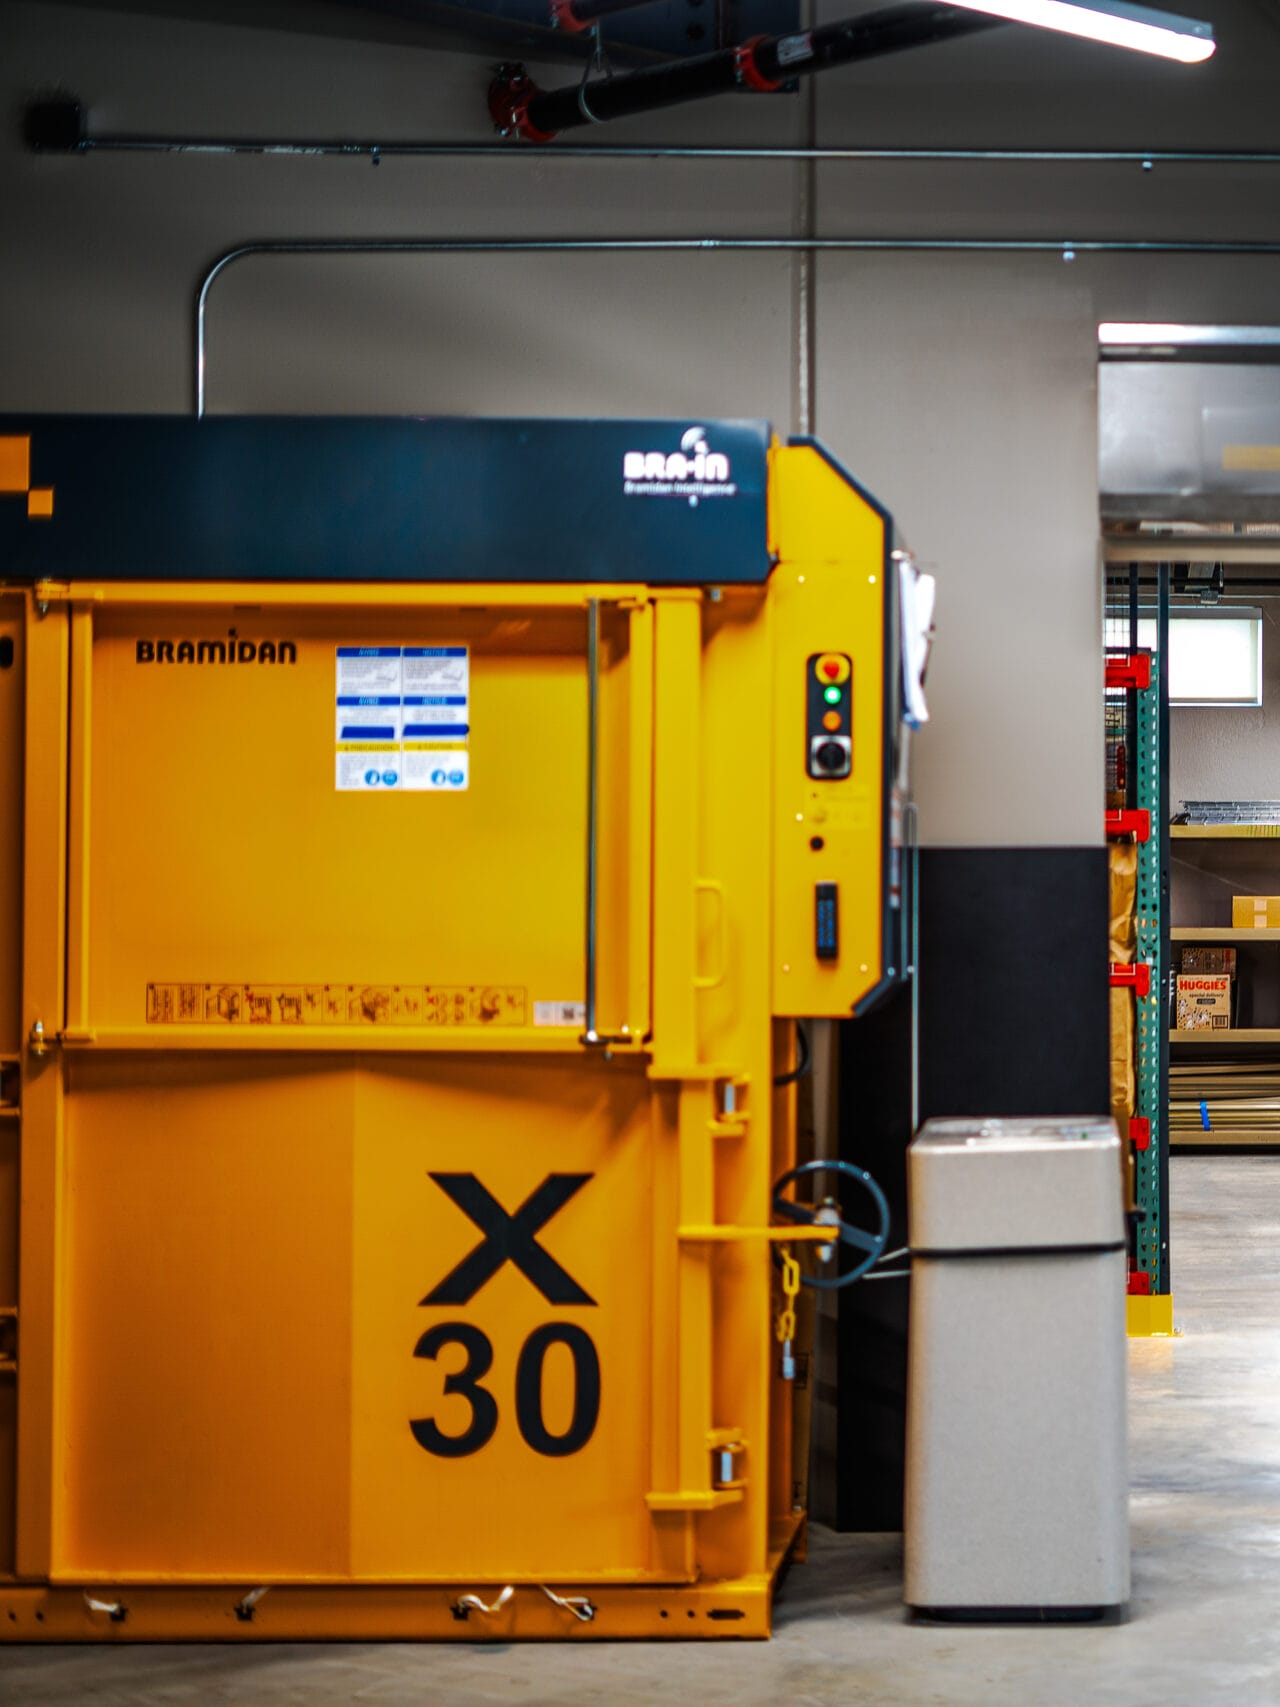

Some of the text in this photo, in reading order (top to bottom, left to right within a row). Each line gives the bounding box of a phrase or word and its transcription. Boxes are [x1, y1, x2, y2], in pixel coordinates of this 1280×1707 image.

[1179, 980, 1226, 990] HUGGIES
[417, 1172, 598, 1307] X
[409, 1321, 601, 1458] 30
